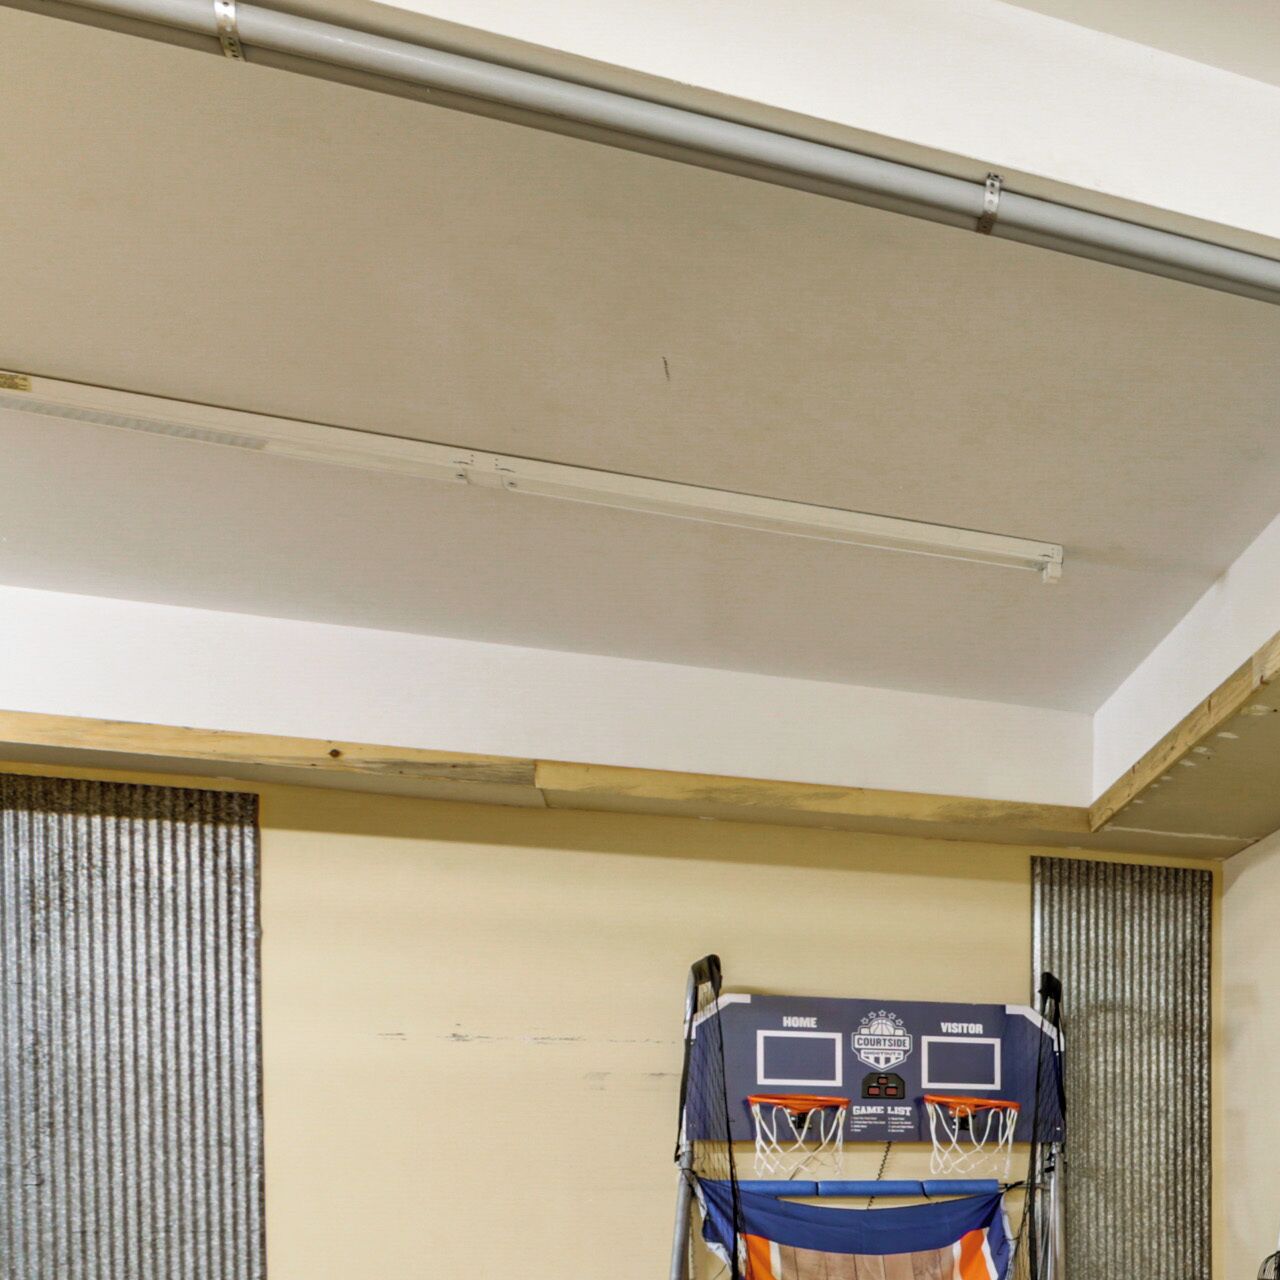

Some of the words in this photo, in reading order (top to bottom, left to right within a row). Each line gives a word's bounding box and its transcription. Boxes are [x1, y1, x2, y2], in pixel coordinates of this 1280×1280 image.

[782, 1016, 817, 1029] HOME
[941, 1022, 984, 1035] VISITOR
[856, 1037, 908, 1048] COURTSIDE
[852, 1106, 885, 1116] GAME
[887, 1106, 912, 1116] LIST
